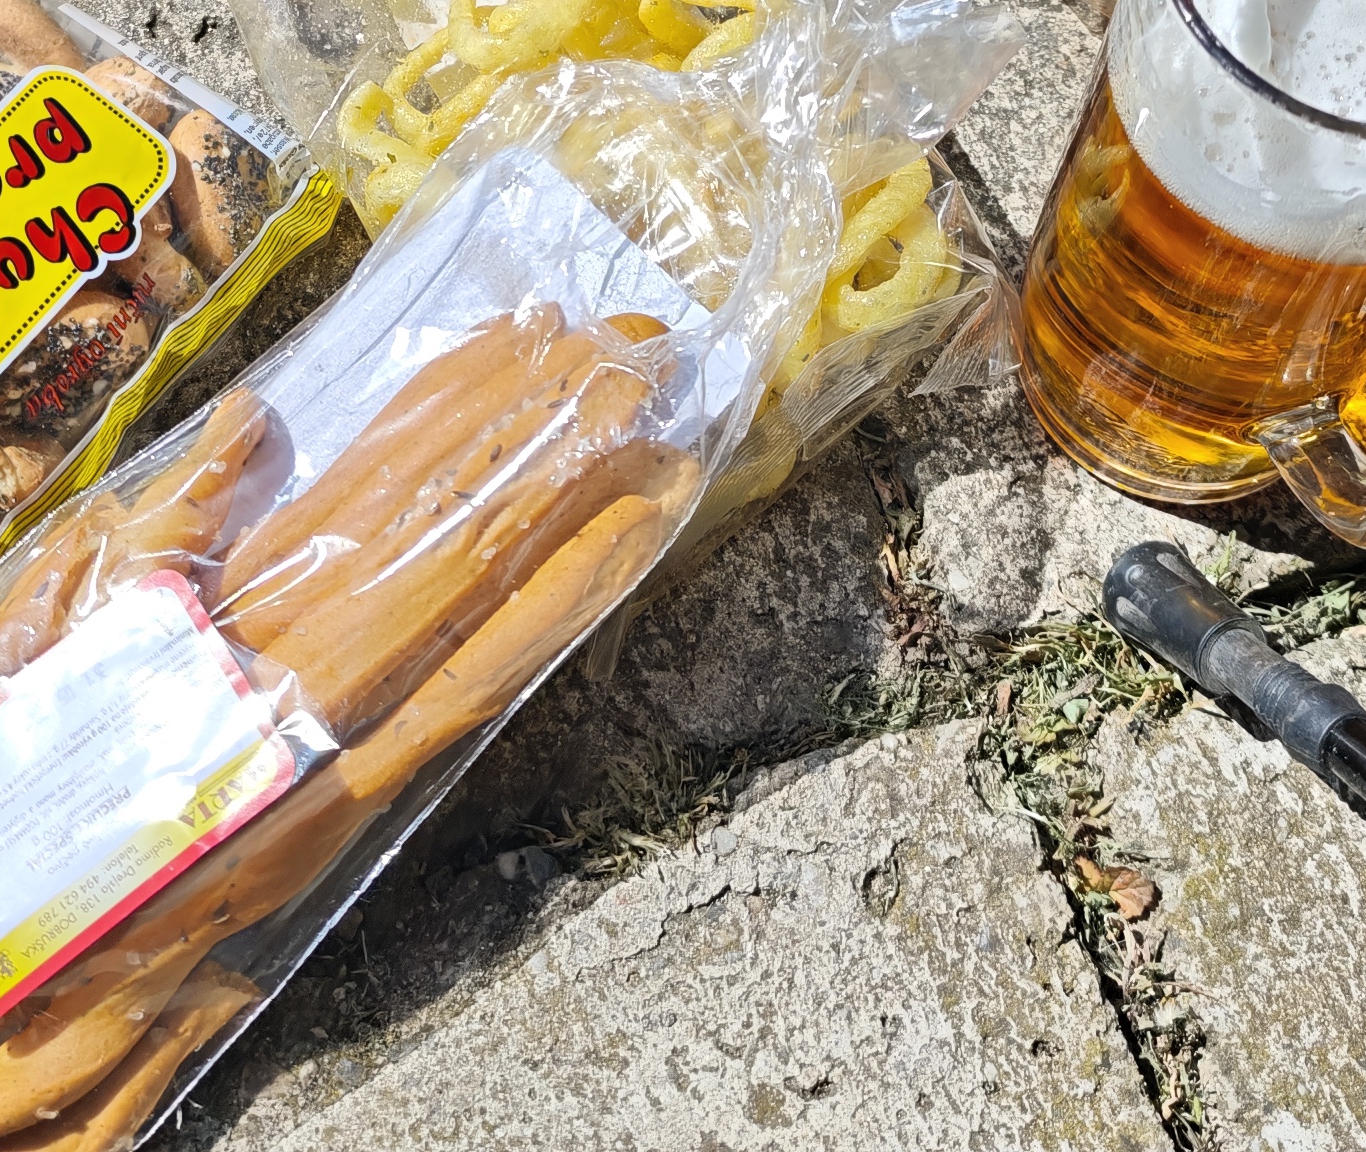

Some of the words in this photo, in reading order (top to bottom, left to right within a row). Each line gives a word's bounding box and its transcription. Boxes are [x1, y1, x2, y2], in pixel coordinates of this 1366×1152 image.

[103, 271, 160, 347] ruční
[28, 833, 42, 847] g
[39, 820, 64, 843] 100
[99, 841, 141, 879] Telefon:
[132, 833, 176, 872] Radima
[75, 871, 103, 896] 494
[56, 888, 82, 912] 621
[72, 891, 102, 918] 138,
[34, 904, 61, 930] 789
[17, 910, 80, 964] DOBRUŠKA
